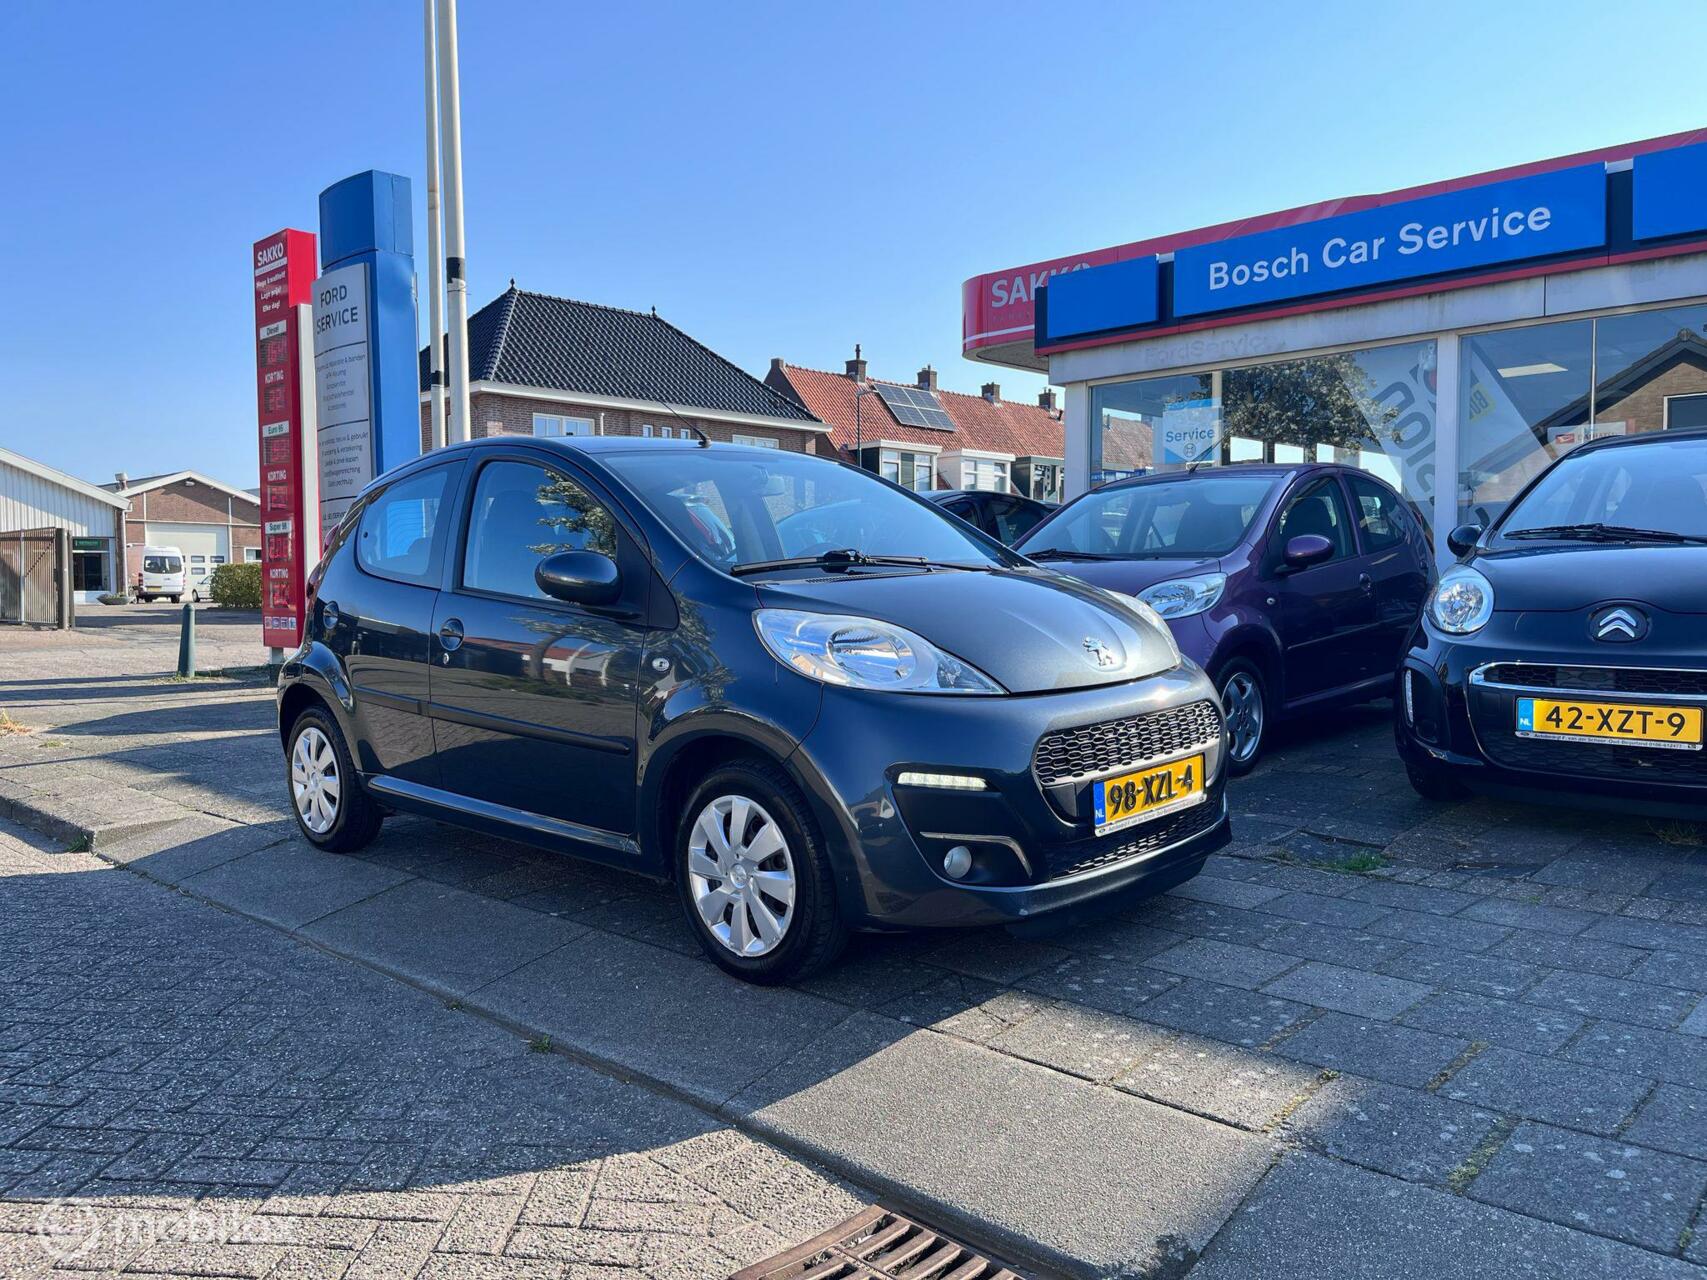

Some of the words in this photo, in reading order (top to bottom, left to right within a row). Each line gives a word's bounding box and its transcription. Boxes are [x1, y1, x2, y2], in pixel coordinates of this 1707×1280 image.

[257, 242, 284, 267] SAKKO
[1209, 247, 1309, 291] Bosch
[1322, 236, 1385, 269] Car
[1397, 207, 1552, 255] Service
[320, 284, 348, 309] FORD
[316, 306, 358, 335] SERVICE
[266, 324, 280, 336] Diesel
[264, 369, 285, 384] KORTING
[267, 425, 278, 434] Euro
[1165, 427, 1215, 443] Service
[267, 470, 287, 481] KORTING
[269, 523, 281, 532] Super
[269, 568, 289, 579] KORTING
[1519, 717, 1531, 727] NL
[1545, 705, 1686, 737] 42-XZT-9
[1108, 764, 1194, 818] 98-XZL-4
[1095, 809, 1105, 820] NL
